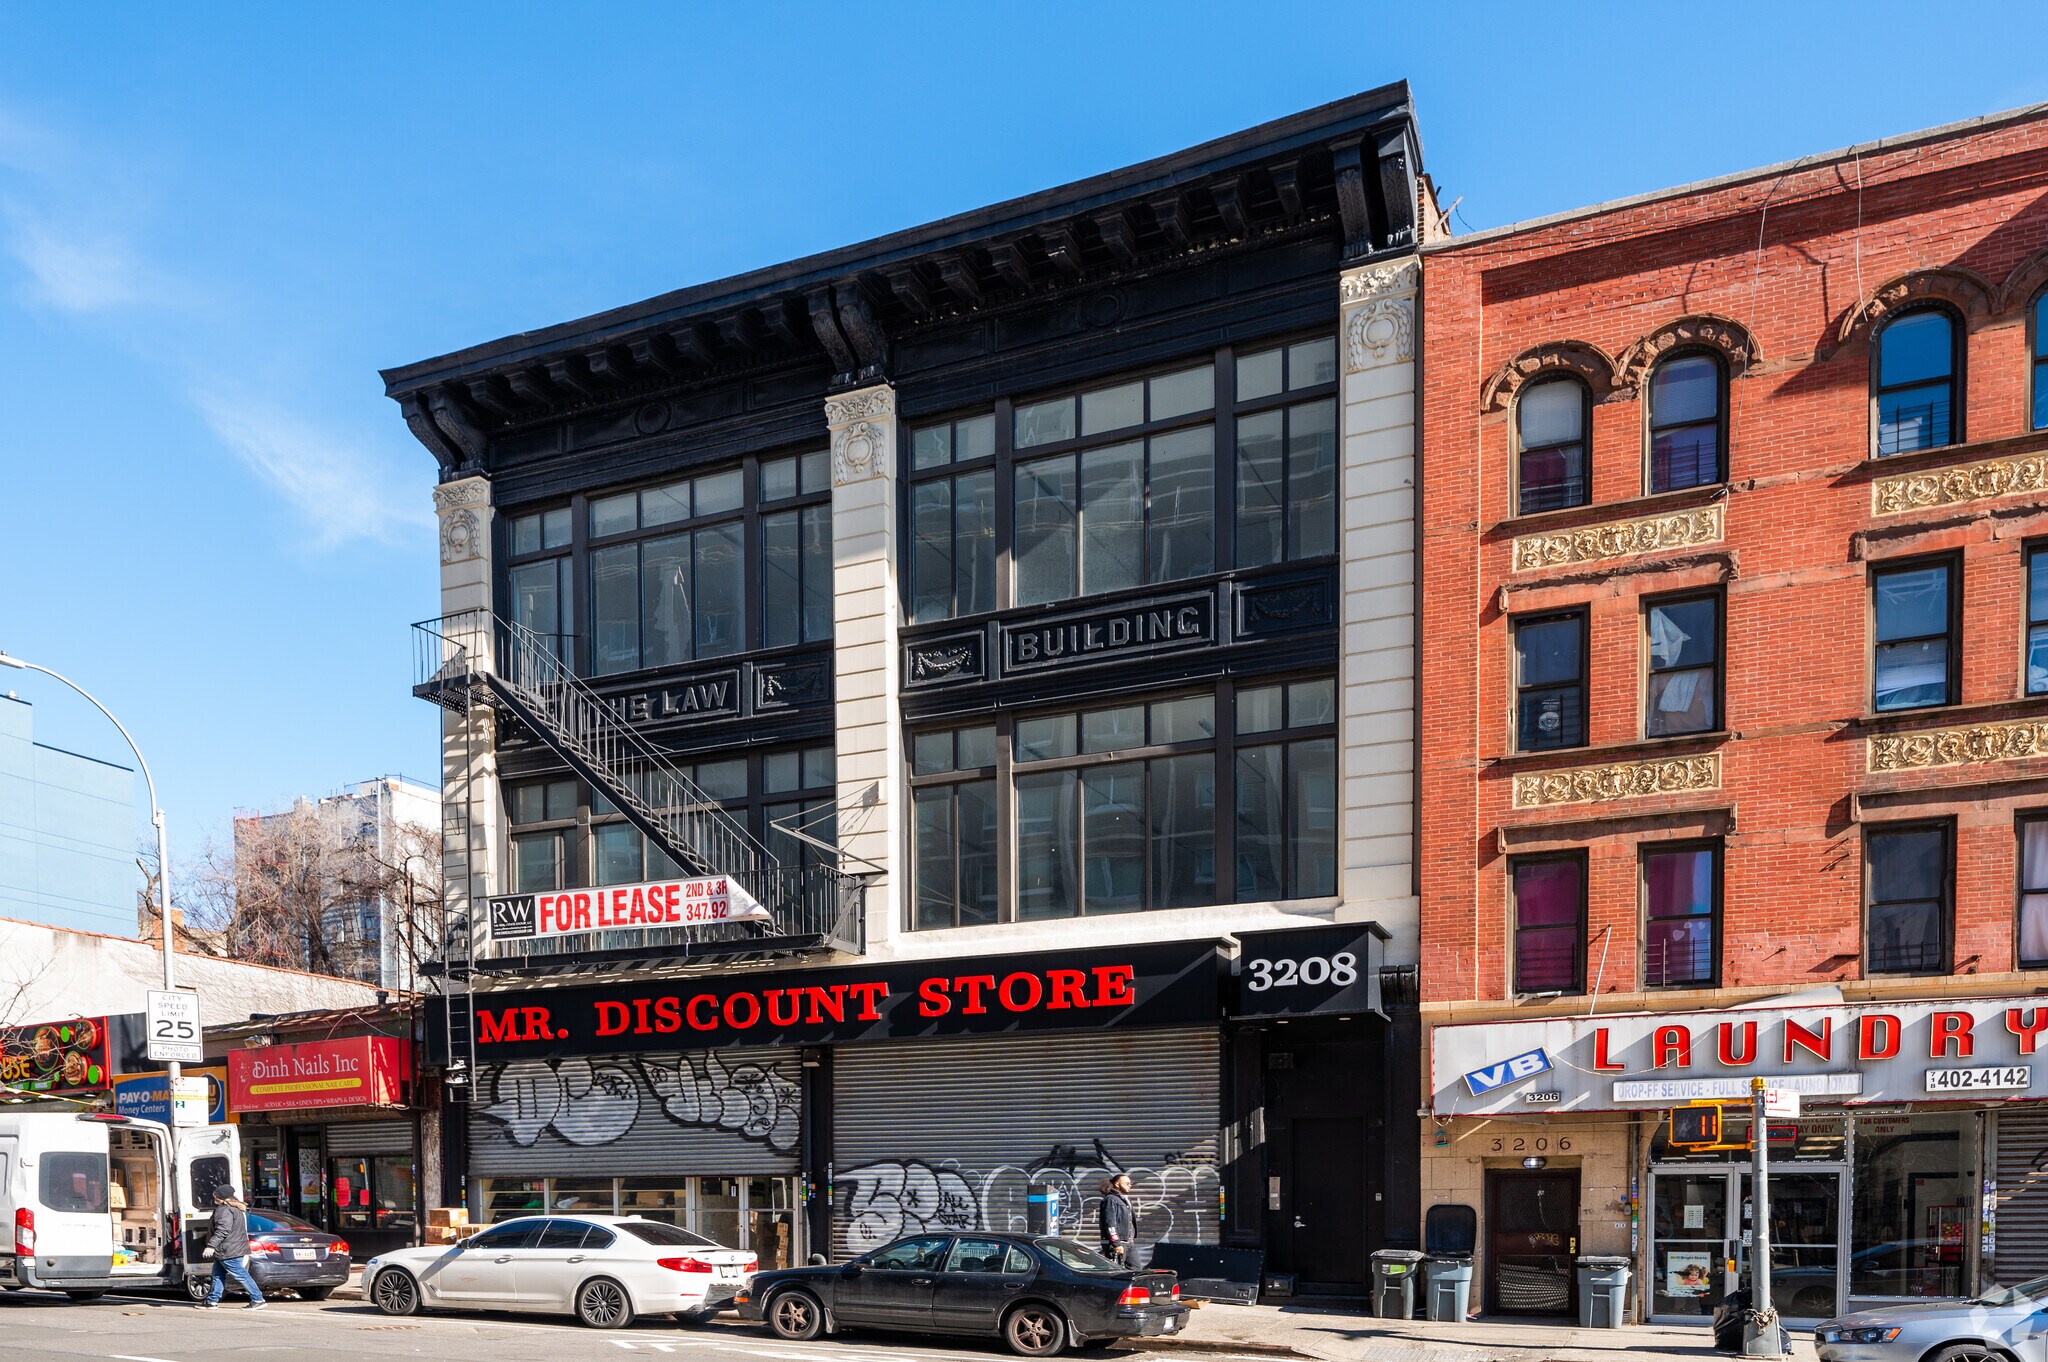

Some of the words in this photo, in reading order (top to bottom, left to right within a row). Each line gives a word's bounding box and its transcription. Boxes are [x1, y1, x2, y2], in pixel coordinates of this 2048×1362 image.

[1015, 606, 1201, 663] BUILDING
[662, 681, 728, 716] LAW
[685, 881, 704, 898] 2ND
[706, 880, 714, 896] &
[715, 879, 728, 896] 3R
[492, 899, 532, 924] RW
[539, 893, 592, 933] FOR
[597, 884, 681, 928] LEASE
[686, 900, 728, 921] 347.92
[1248, 952, 1358, 993] 3208
[158, 1002, 188, 1010] SPEED
[476, 1006, 569, 1044] MR.
[595, 982, 890, 1037] DISCOUNT
[918, 964, 1136, 1018] STORE
[156, 1019, 195, 1039] 25
[1593, 1006, 2048, 1072] LAUNDRY
[154, 1051, 198, 1059] ENFORCED
[0, 1055, 30, 1080] USE
[293, 1053, 330, 1077] Nails
[332, 1053, 359, 1073] Inc
[1472, 1053, 1545, 1088] VB
[256, 1085, 284, 1094] COMPLETE
[285, 1082, 325, 1092] PROFESSIONAL
[326, 1081, 339, 1089] NAIL
[339, 1079, 355, 1088] CARE
[1937, 1067, 2028, 1089] 402-4142
[119, 1089, 171, 1104] PAY-O-MA
[1528, 1093, 1559, 1102] 3206
[1661, 1081, 1704, 1098] SERVICE
[1712, 1080, 1738, 1097] FULL
[118, 1105, 139, 1116] Money
[140, 1103, 166, 1114] Centers
[326, 1097, 343, 1105] WRAPS
[1811, 1124, 1834, 1134] ONLY
[1873, 1116, 1910, 1125] CUSTOMERS
[1875, 1126, 1895, 1134] ONLY
[1491, 1136, 1572, 1152] 3206
[944, 1192, 970, 1210] ALL
[1051, 1202, 1057, 1215] P
